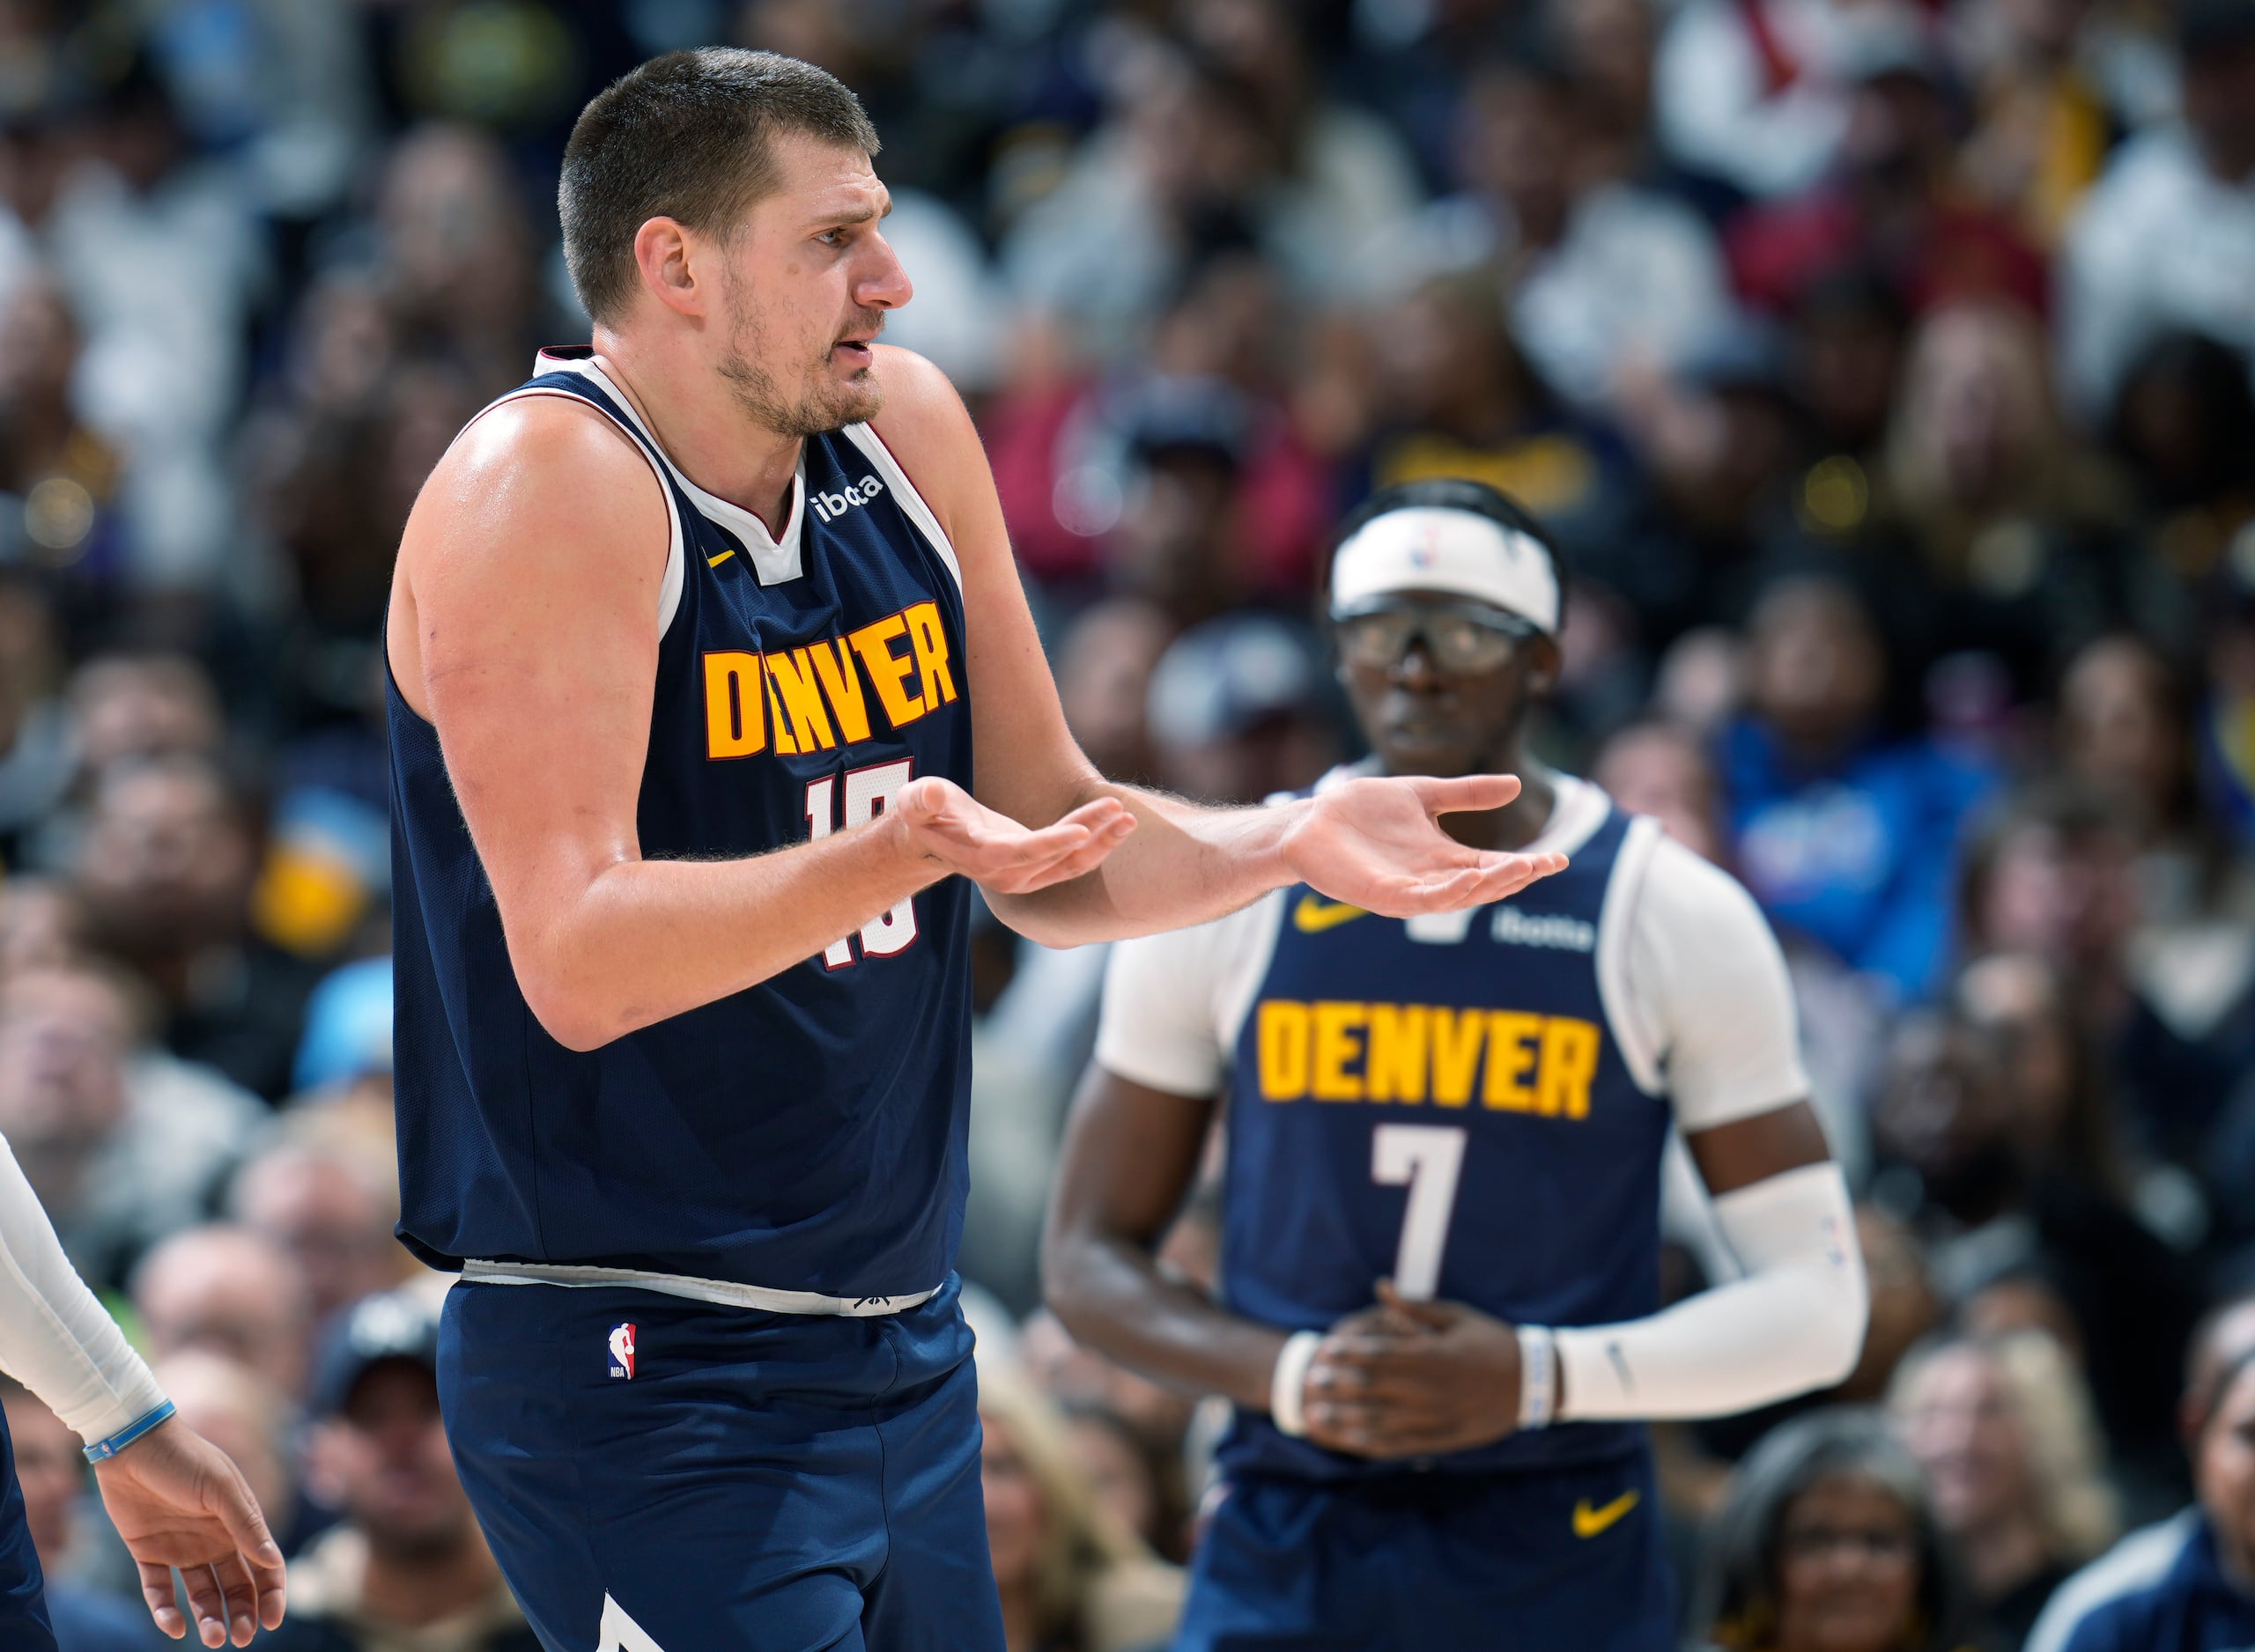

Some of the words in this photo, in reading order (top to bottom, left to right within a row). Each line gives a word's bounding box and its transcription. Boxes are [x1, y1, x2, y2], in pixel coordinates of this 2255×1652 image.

[701, 598, 960, 762] DENVER
[1257, 999, 1601, 1121] DENVER
[1371, 1124, 1468, 1302] 7
[610, 1366, 625, 1378] NBA
